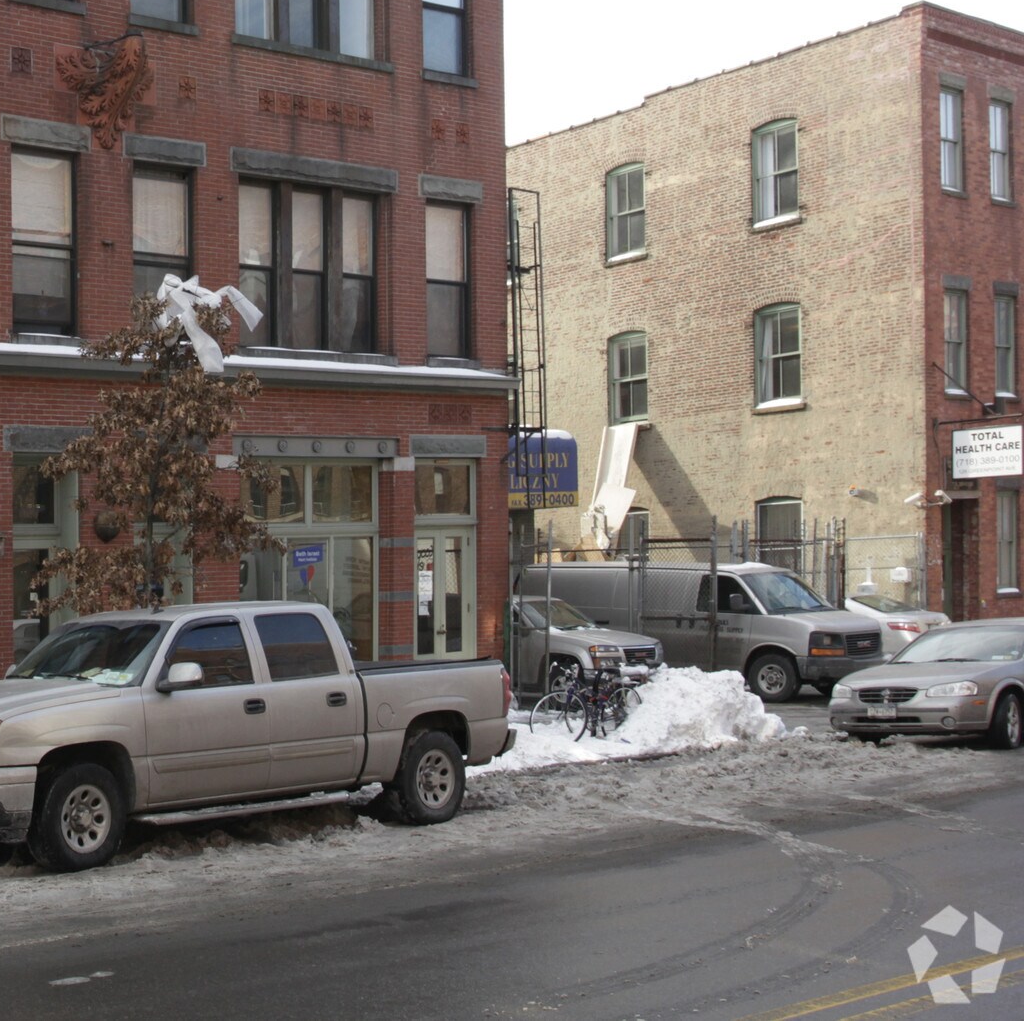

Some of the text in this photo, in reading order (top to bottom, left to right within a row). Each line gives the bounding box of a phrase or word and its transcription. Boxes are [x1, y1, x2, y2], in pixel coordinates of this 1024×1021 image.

[971, 431, 1004, 441] TOTAL
[955, 441, 1021, 454] HEALTH CARE
[956, 458, 978, 468] (718)
[523, 493, 575, 507] 389-0400
